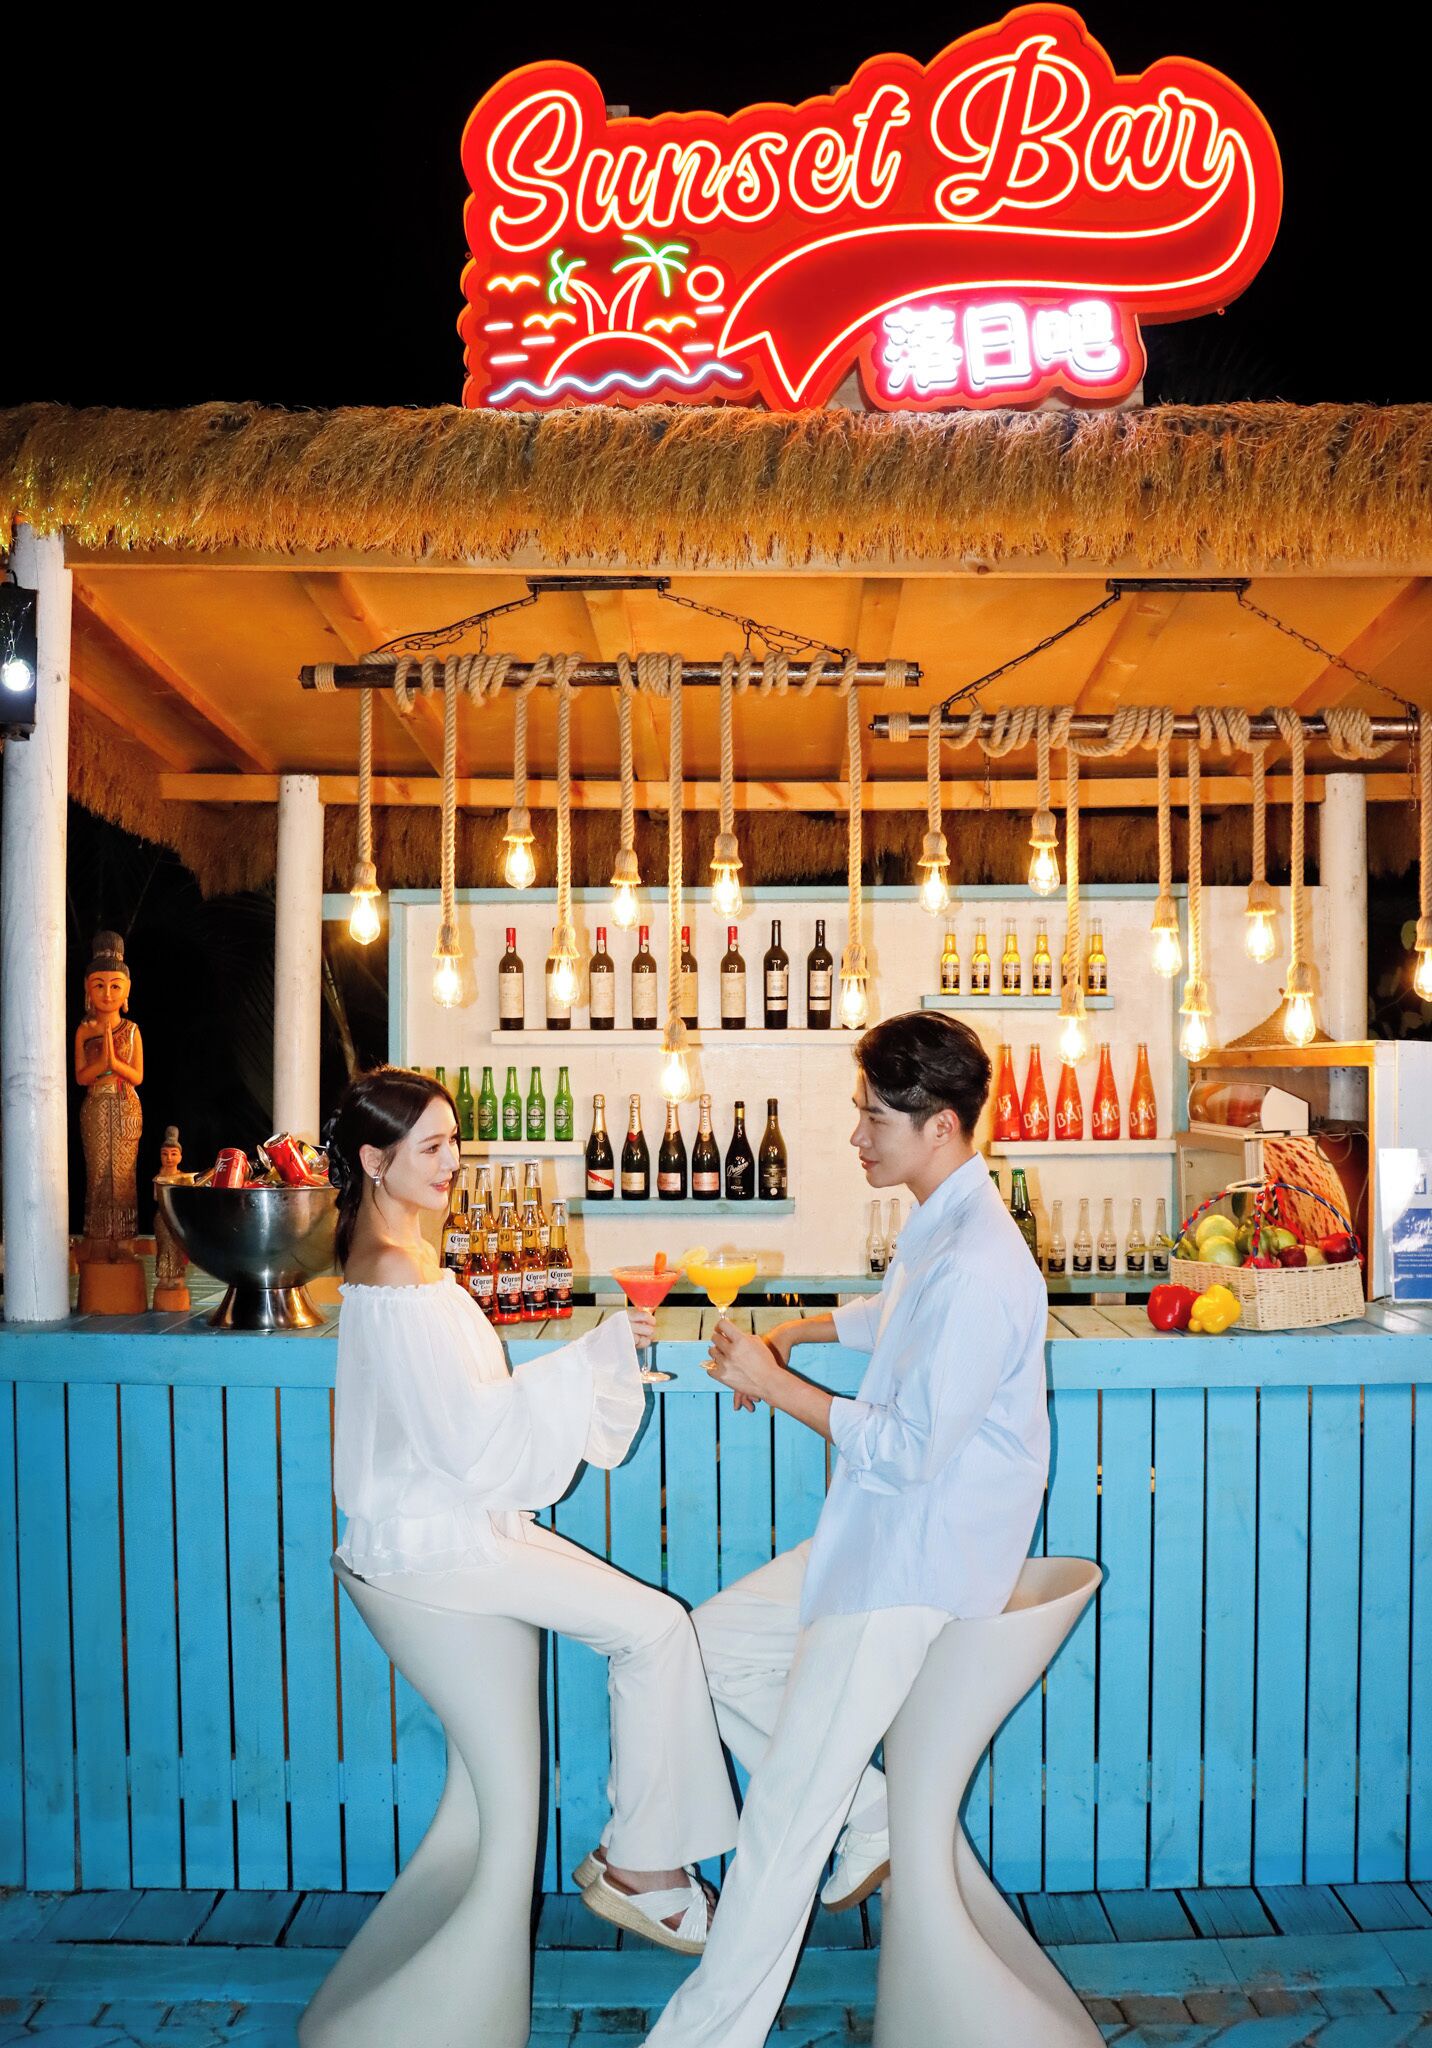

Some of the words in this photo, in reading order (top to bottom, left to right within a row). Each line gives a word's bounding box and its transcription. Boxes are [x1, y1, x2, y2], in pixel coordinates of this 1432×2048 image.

[489, 84, 910, 254] Sunset
[930, 35, 1236, 223] Bar
[883, 300, 1121, 392] 落日吧
